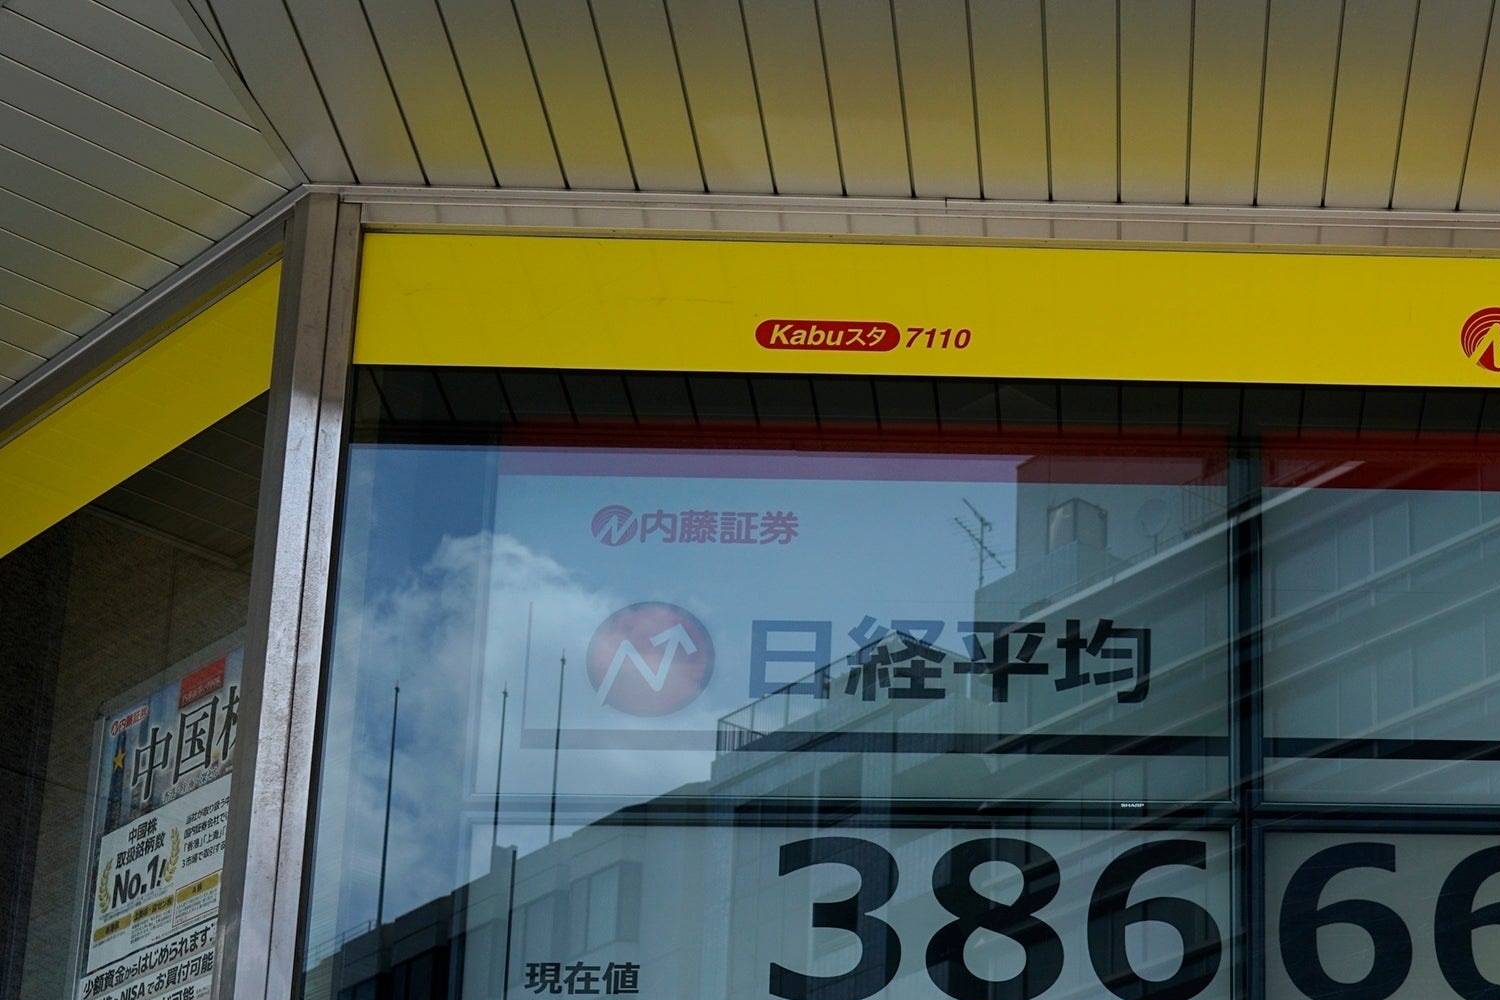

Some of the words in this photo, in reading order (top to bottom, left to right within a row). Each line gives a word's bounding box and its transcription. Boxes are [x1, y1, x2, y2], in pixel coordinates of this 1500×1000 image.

[769, 324, 887, 347] Kabuスタ
[905, 328, 972, 349] 7110
[639, 509, 799, 545] 内藤証券
[749, 615, 1152, 703] 日経平均
[128, 817, 158, 844] 中国株
[116, 831, 166, 870] 取扱銘柄数
[111, 854, 167, 909] No.1!
[524, 961, 641, 995] 現在値
